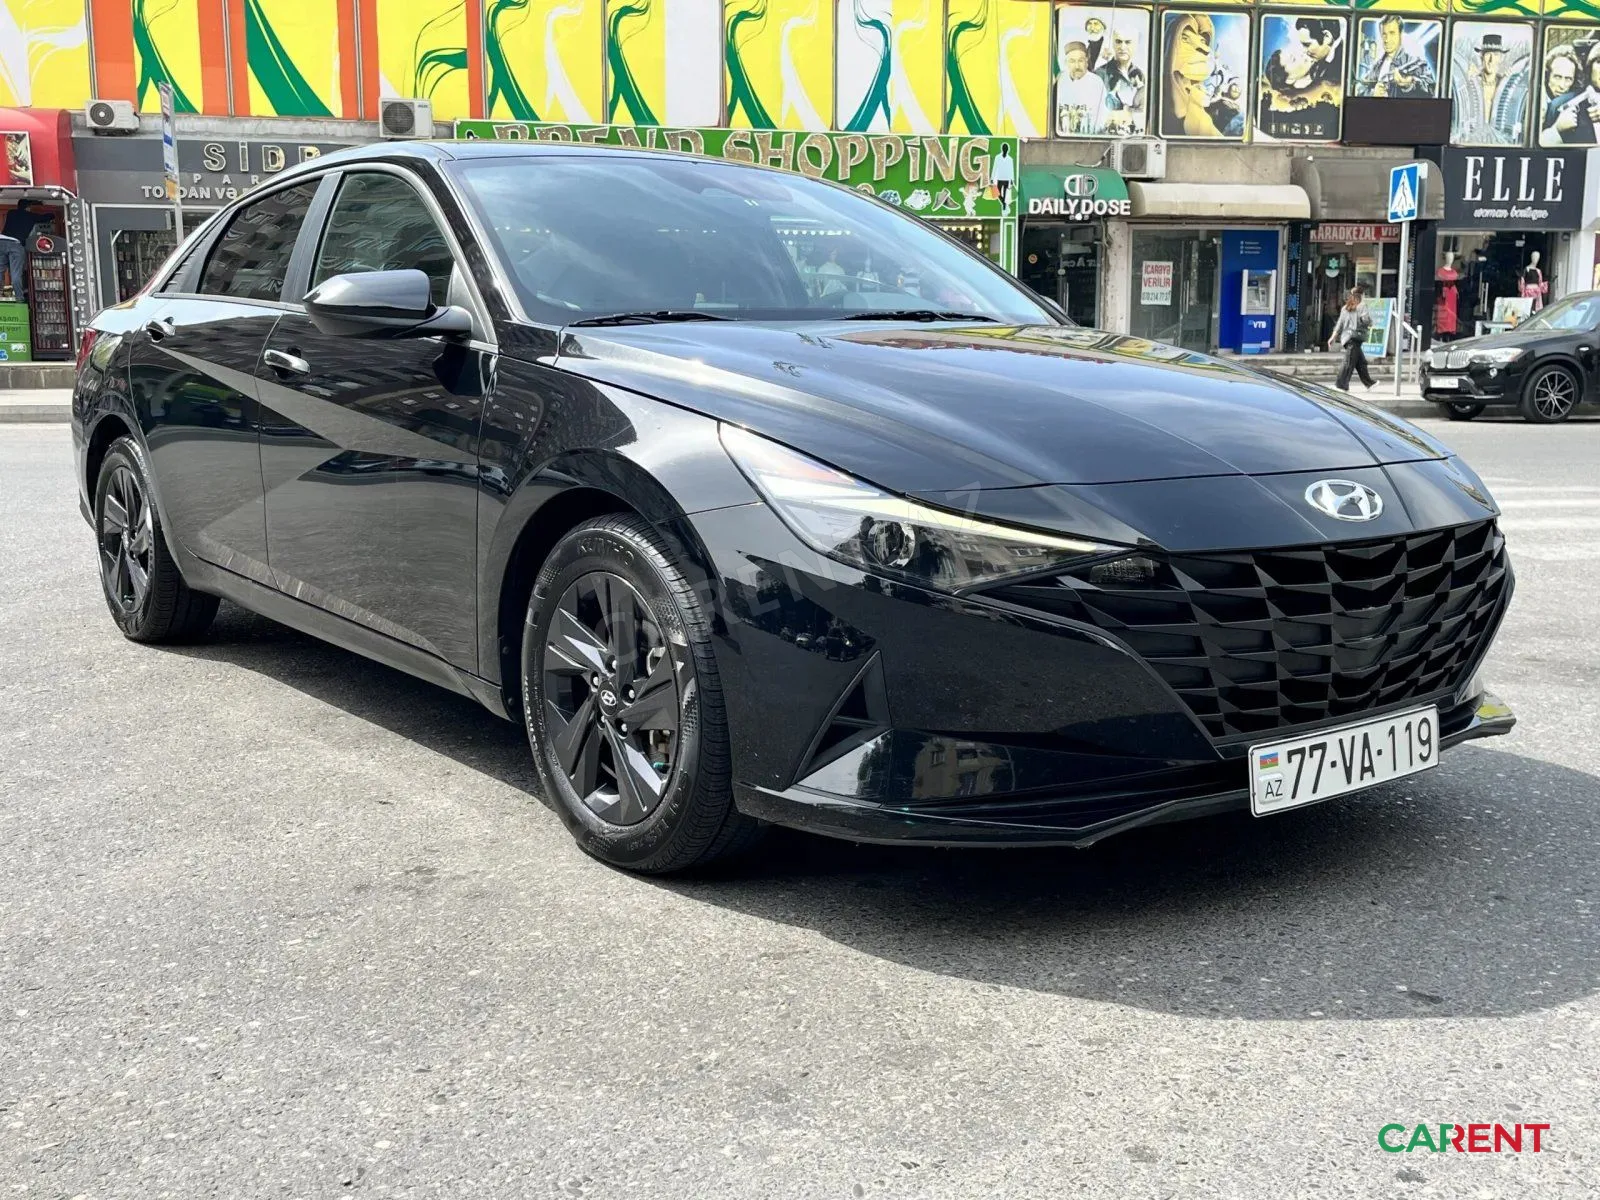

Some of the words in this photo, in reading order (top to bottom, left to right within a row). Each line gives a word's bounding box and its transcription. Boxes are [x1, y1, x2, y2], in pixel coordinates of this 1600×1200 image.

[1462, 155, 1565, 202] ELLE
[141, 185, 211, 200] TODAN
[1028, 198, 1079, 215] DAILY
[1081, 199, 1132, 216] DOSE
[1473, 207, 1509, 219] woman
[1510, 205, 1549, 221] boutique
[1264, 779, 1283, 799] AZ
